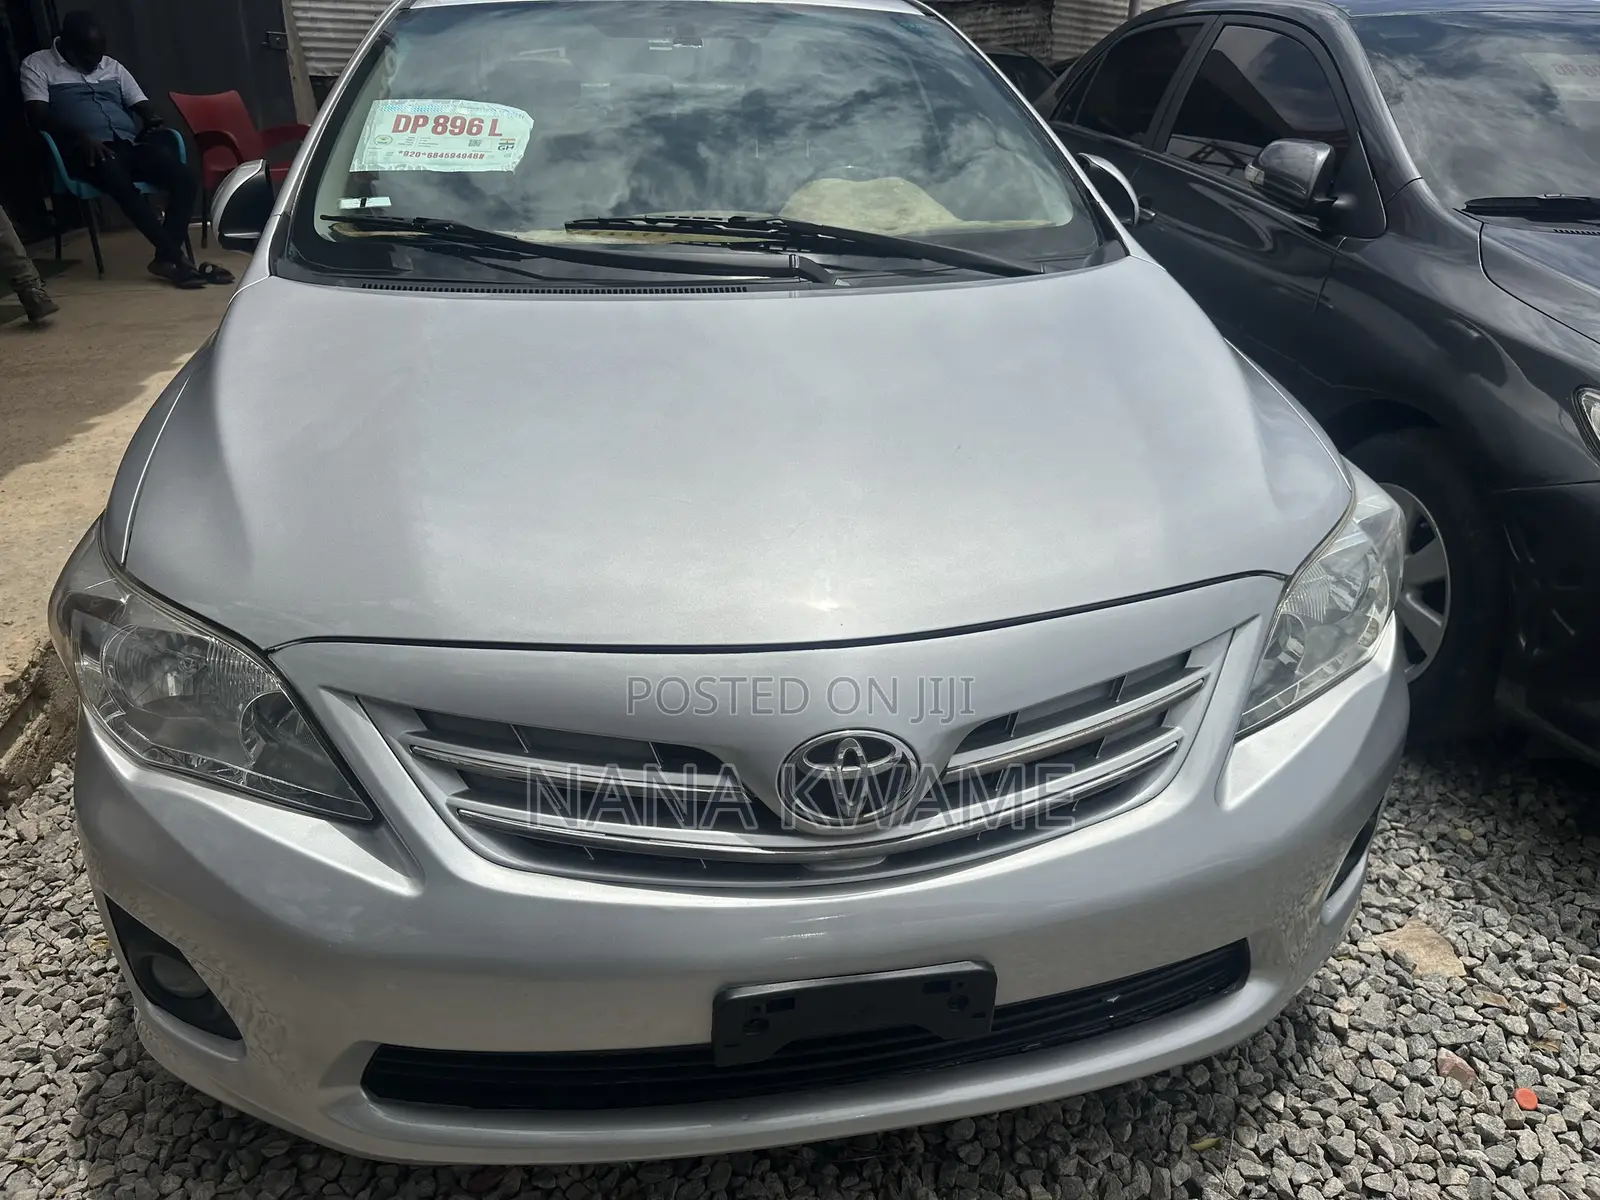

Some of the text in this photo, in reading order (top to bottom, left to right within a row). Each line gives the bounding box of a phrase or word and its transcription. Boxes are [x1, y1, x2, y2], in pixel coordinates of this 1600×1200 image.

[391, 113, 503, 137] DP 896 L
[497, 144, 515, 152] GH
